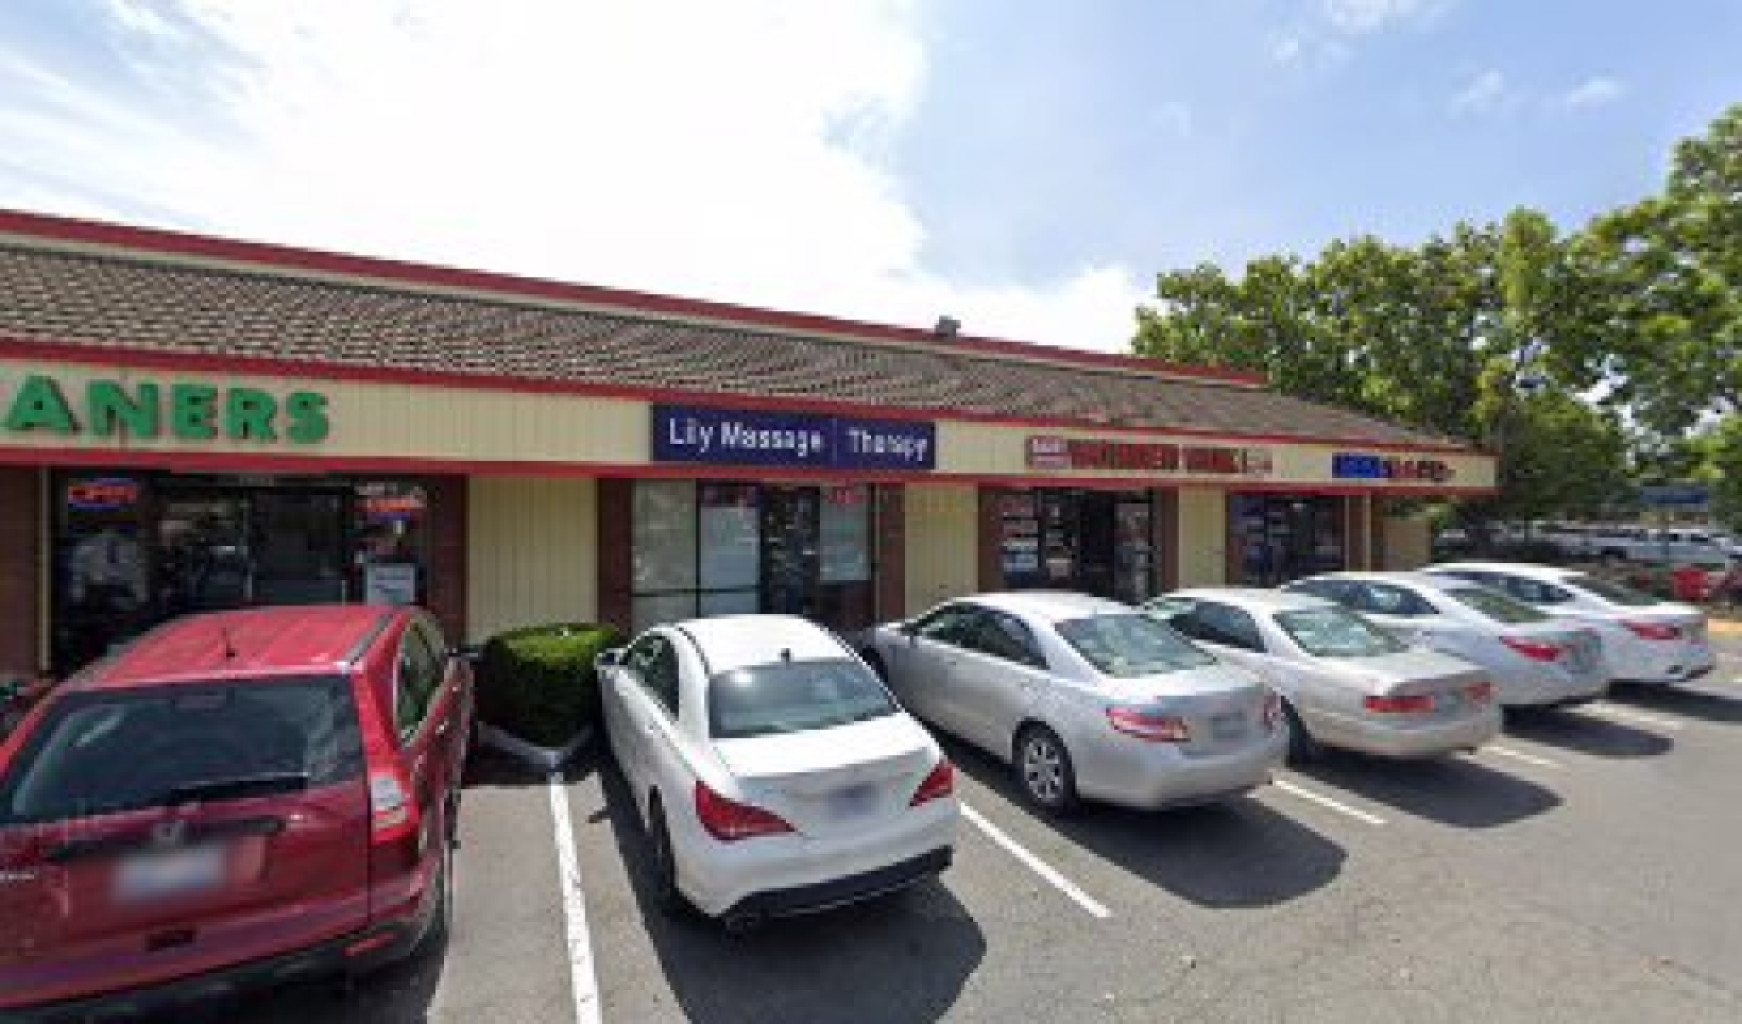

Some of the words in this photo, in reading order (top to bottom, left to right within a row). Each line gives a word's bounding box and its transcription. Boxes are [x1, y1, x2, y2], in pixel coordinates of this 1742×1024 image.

[2, 375, 330, 444] ANERS
[669, 418, 714, 453] Lily
[721, 422, 824, 457] Massage
[849, 428, 929, 461] Therapy
